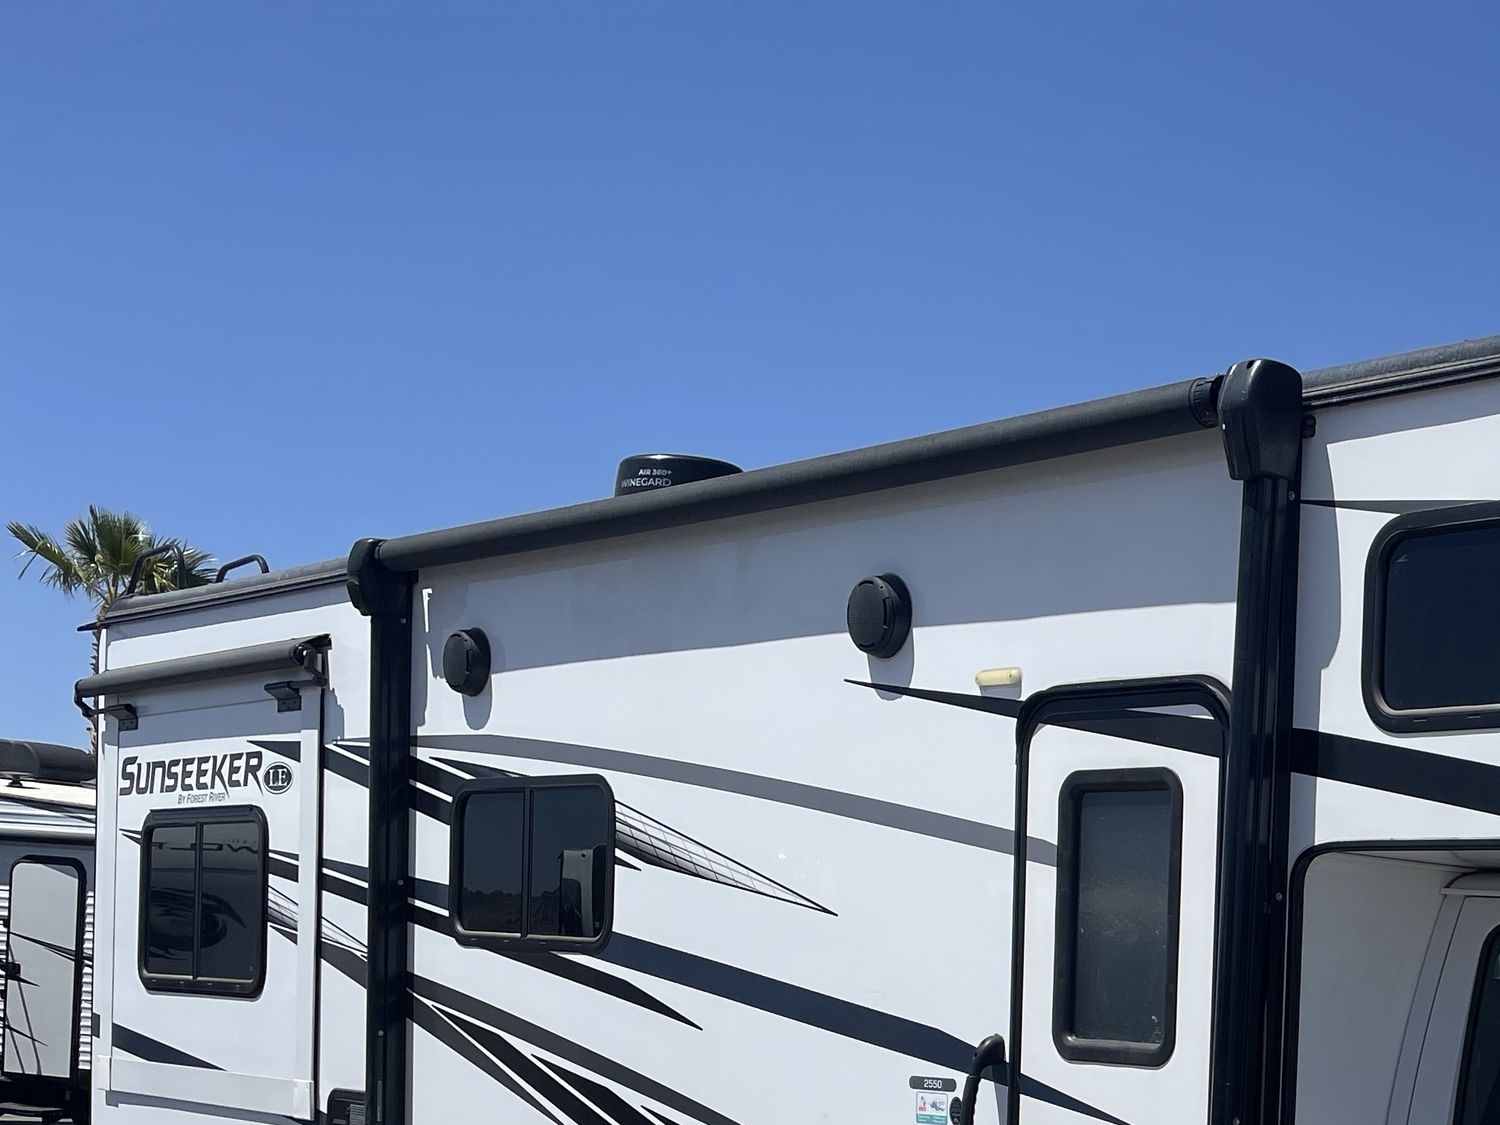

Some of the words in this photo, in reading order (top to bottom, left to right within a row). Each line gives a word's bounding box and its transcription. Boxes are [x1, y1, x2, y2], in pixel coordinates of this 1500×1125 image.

[621, 478, 672, 488] WINEGARD
[268, 768, 288, 787] LE
[187, 793, 208, 803] FOREST
[209, 791, 226, 802] RIVER
[923, 1079, 943, 1089] 2550
